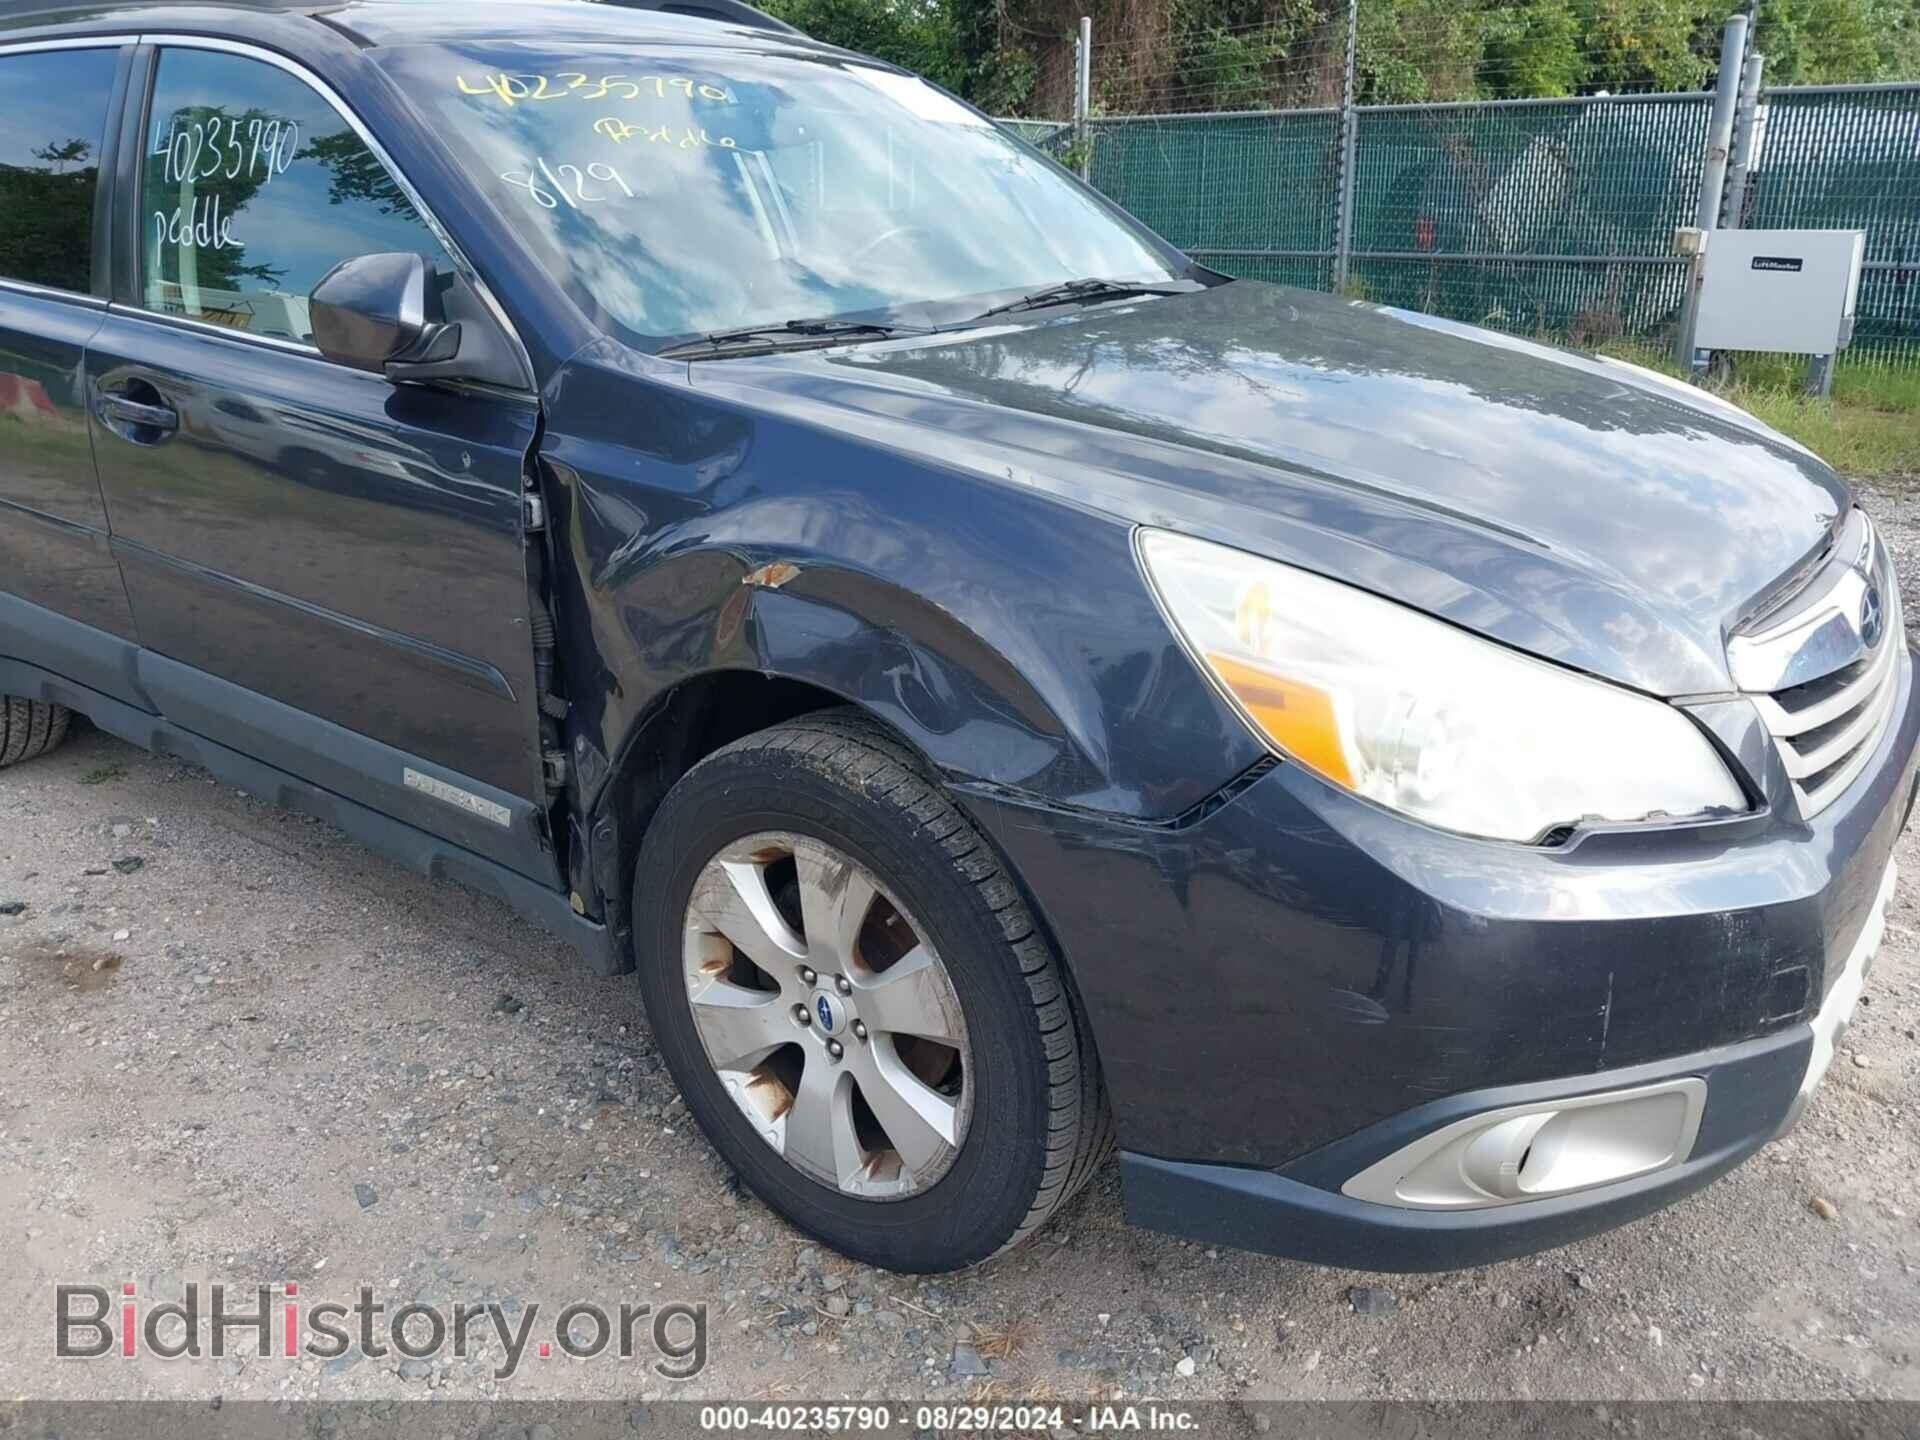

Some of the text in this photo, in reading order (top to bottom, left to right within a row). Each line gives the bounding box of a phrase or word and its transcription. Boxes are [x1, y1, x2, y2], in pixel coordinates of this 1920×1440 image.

[457, 73, 728, 106] 40235790
[153, 116, 299, 184] 40235790
[500, 156, 635, 208] 8/29
